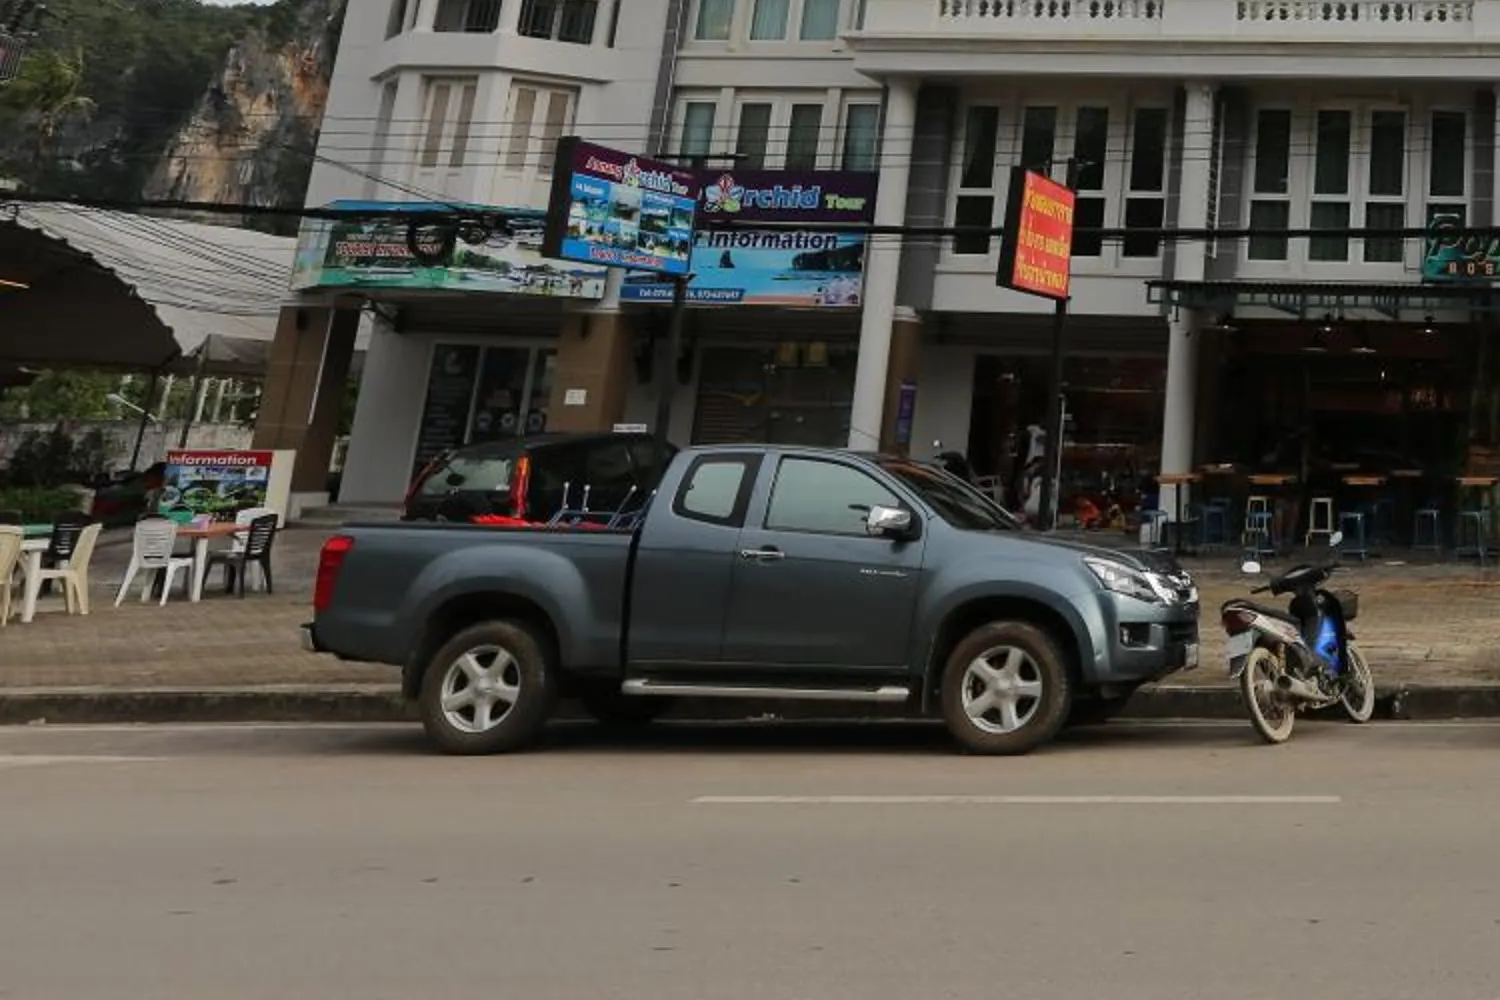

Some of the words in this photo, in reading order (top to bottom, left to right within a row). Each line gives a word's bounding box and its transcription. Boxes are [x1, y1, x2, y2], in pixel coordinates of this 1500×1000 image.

[825, 193, 866, 210] Tour
[708, 230, 838, 250] Information
[169, 453, 256, 466] Information
